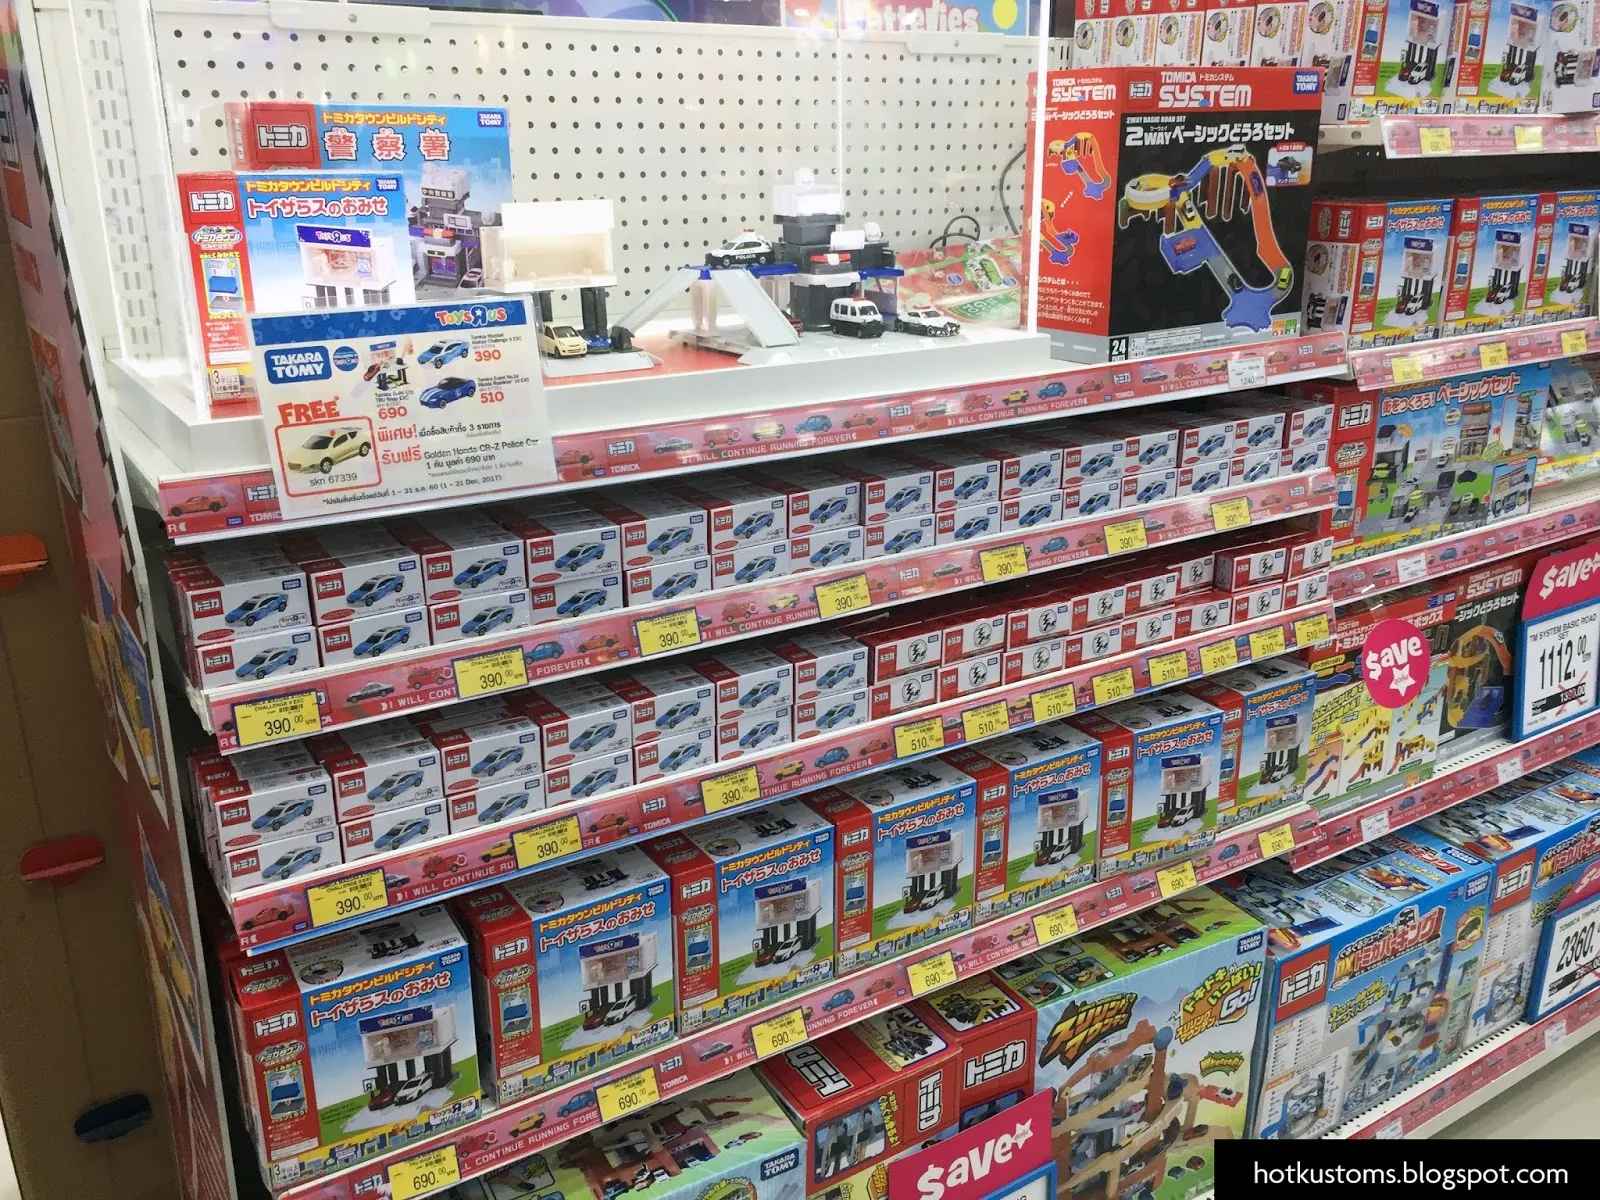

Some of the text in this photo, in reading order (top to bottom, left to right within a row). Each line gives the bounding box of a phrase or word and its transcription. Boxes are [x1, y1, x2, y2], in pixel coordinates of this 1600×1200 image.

[1052, 78, 1076, 86] TOMICA
[1161, 71, 1235, 83] TOMICA トミカシステム
[1296, 74, 1318, 83] TAKARA
[1051, 84, 1116, 102] SYSTEM
[1129, 81, 1152, 98] トミカ
[1296, 82, 1317, 92] TOMY
[1158, 85, 1251, 108] SYSTEM
[322, 112, 447, 127] トミカタウンビルドシティ
[478, 112, 502, 120] TAKARA
[258, 124, 310, 149] トミカ
[1125, 122, 1294, 147] 2WAYベーシックどうろセット
[246, 180, 370, 193] トミカタウンビルドシティ
[191, 191, 233, 213] トミカ
[247, 196, 387, 218] トイザらスのおみせ
[1387, 215, 1444, 232] トイザらスのおみせ
[1460, 208, 1477, 223] トミカ
[1481, 209, 1532, 226] トイザらスのおみせ
[735, 253, 756, 261] POLICE
[474, 350, 501, 362] 390
[1112, 340, 1126, 355] 24
[271, 352, 324, 365] TAKARA
[273, 363, 323, 378] TOMY
[1187, 377, 1217, 387] CONTINUE
[1435, 372, 1521, 405] ベーシックセット
[480, 391, 504, 404] 510
[378, 406, 407, 419] 690
[958, 399, 1085, 424] WILL CONTINUE RUNNING FOREVER
[1339, 401, 1371, 430] トミカ
[469, 424, 474, 432] 3
[892, 425, 915, 434] TOMICA
[382, 440, 524, 466] รับฟรี Golden Honda CR-Z Police
[608, 440, 637, 456] トミカ
[721, 433, 851, 460] CONTINUE RUNNING FOREVER
[466, 456, 480, 464] 690
[610, 463, 640, 473] TOMICA
[310, 473, 357, 487] skn 67339
[482, 475, 502, 484] 2017)
[1055, 552, 1087, 563] FOREVER
[1467, 568, 1522, 600] SYSTEM
[715, 616, 783, 637] WILL CONTINUE
[1538, 626, 1562, 640] SYSTEM
[1562, 619, 1580, 633] BASIC
[1580, 613, 1597, 626] ROAD
[1558, 630, 1569, 640] SET
[536, 659, 584, 677] FOREVER
[397, 694, 421, 706] WILL
[1247, 692, 1308, 719] トイザらスのおみせ
[1137, 730, 1213, 759] トイザらスのおみせ
[792, 761, 868, 788] RUNNING FOREVER
[1013, 763, 1091, 798] トイザらスのおみせ
[642, 797, 667, 813] トミカ
[877, 794, 956, 824] トミカタウンビルドシティ
[643, 818, 671, 831] TOMICA
[877, 803, 965, 842] トイザらスのおみせ
[842, 827, 870, 846] トミカ
[720, 839, 810, 875] トミカタウンビルドシティ
[1203, 854, 1256, 878] RUNNING FOREVER
[721, 849, 821, 892] トイザらスのおみせ
[412, 866, 496, 896] WILL CONTINUE
[682, 877, 712, 899] トミカ
[1496, 863, 1532, 897] トミカ
[1467, 882, 1488, 897] TOMY
[539, 894, 643, 932] トミカタウンビルドシティ
[539, 901, 656, 952] トイザらスのおみせ
[493, 937, 530, 960] トミカ
[1239, 940, 1261, 954] TOMY
[1240, 934, 1261, 947] TAKARA
[442, 956, 461, 966] TOMY
[986, 946, 1020, 963] CONTINUE
[241, 959, 280, 977] トミカ
[309, 961, 435, 1005] トミカタウンビルドシティ
[1281, 962, 1325, 1006] トミカ
[310, 971, 451, 1027] トイザらスのおみせ
[837, 1001, 873, 1019] FOREVER
[255, 1011, 298, 1038] トミカ
[659, 1055, 683, 1073] トミカ
[964, 1040, 1027, 1089] トミカ
[662, 1075, 688, 1090] TOMICA
[917, 1069, 943, 1132] トミカ
[476, 1121, 570, 1166] CONTINUE RUNNING
[763, 1152, 796, 1168] TAKARA
[764, 1160, 796, 1176] TOMY
